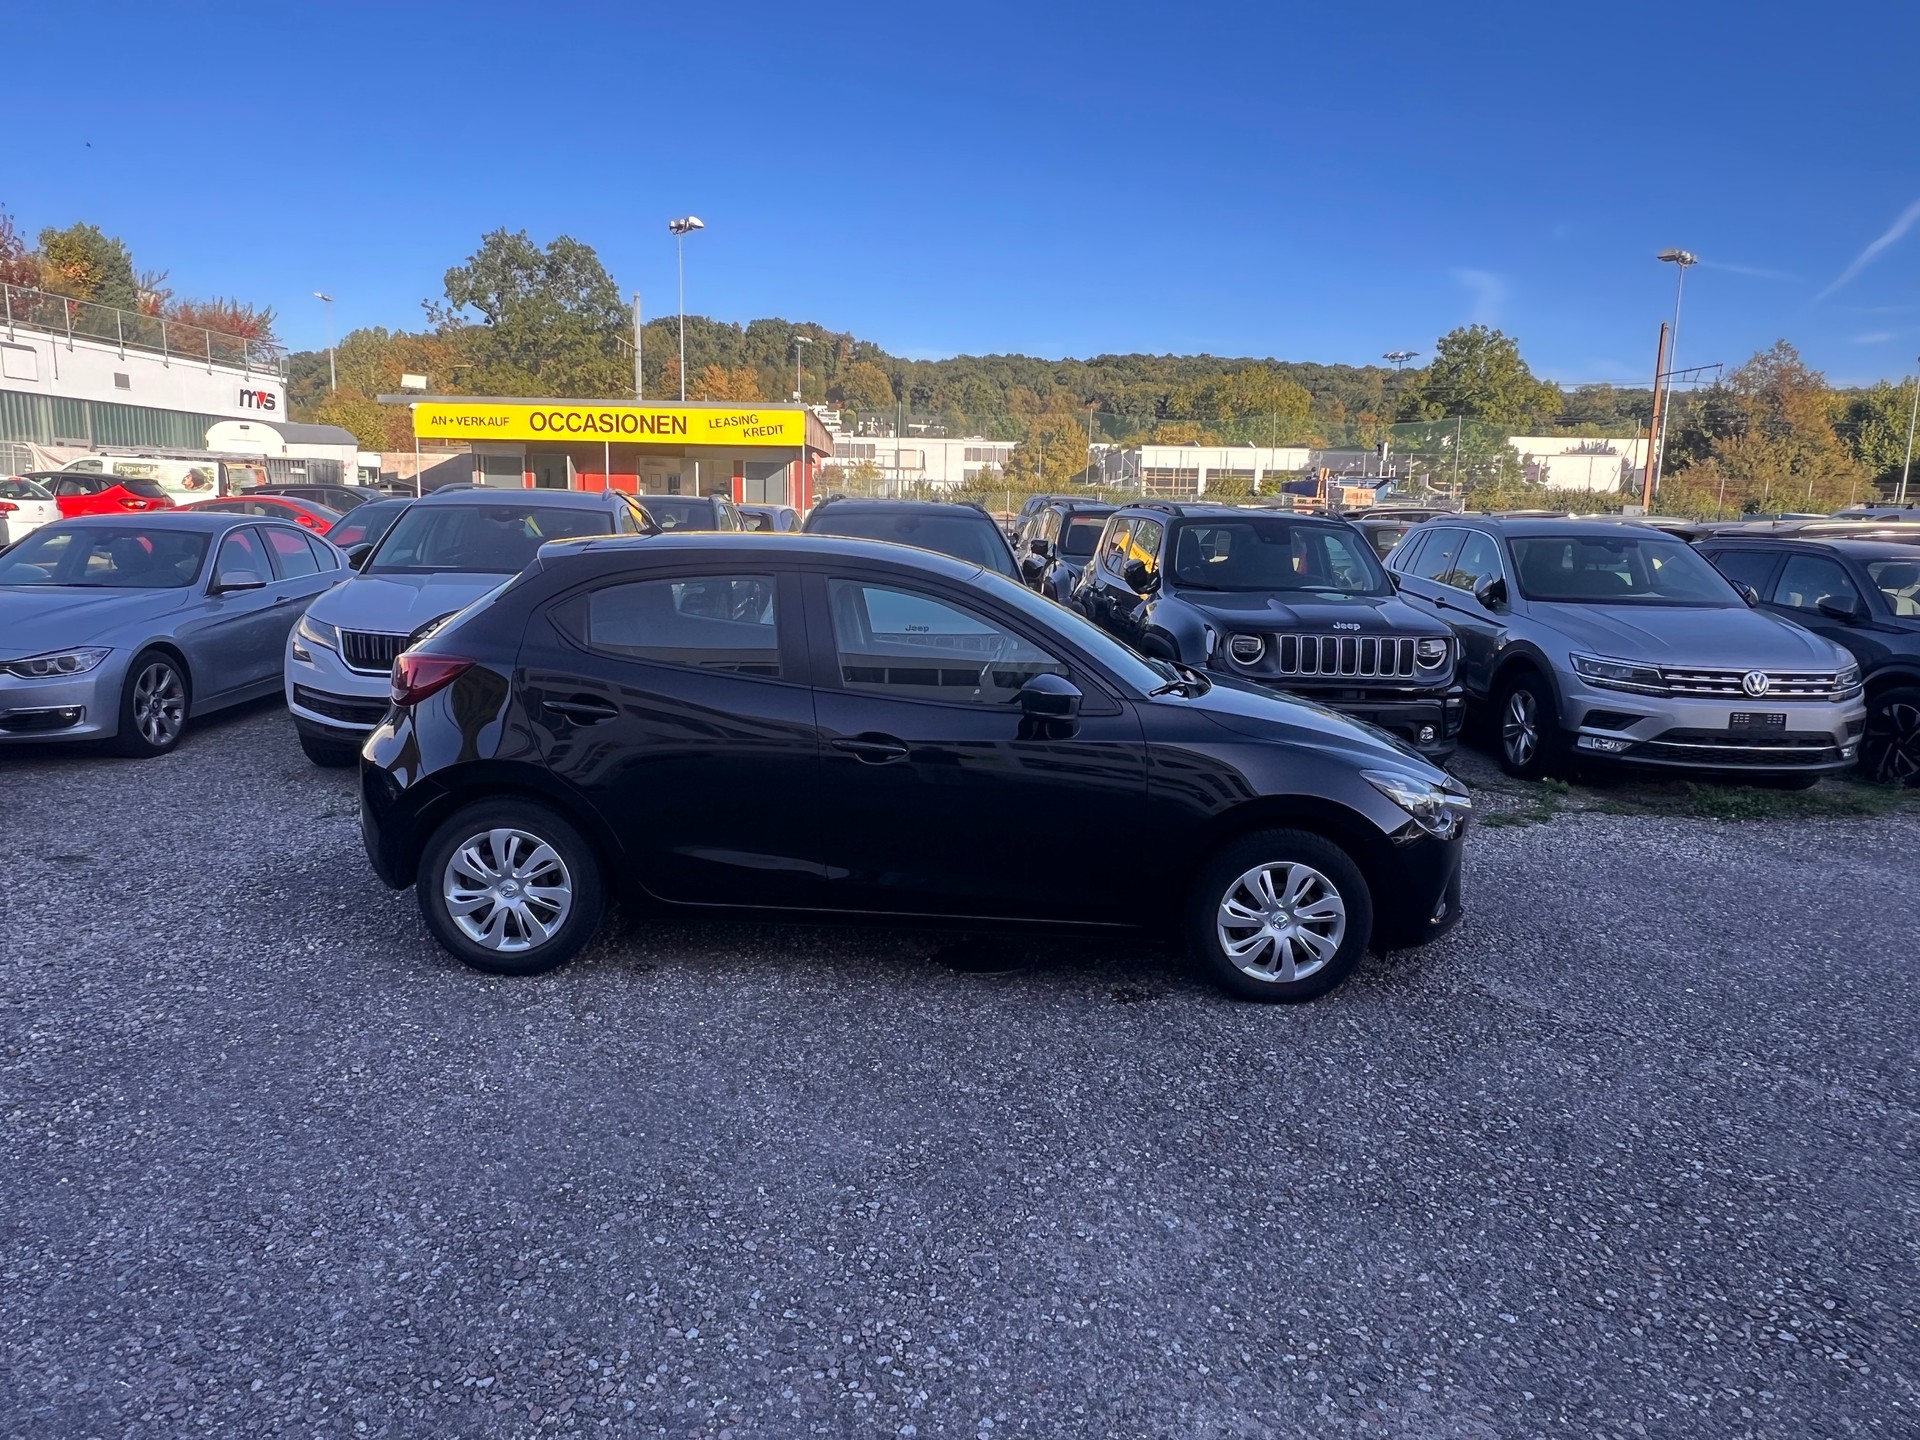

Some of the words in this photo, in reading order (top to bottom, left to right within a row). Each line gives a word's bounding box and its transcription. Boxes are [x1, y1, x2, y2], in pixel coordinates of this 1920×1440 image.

[431, 415, 447, 426] AN
[455, 416, 510, 427] VERKAUF
[529, 411, 687, 435] OCCASIONEN
[708, 413, 759, 429] LEASING
[743, 424, 784, 438] KREDIT
[115, 463, 151, 475] Inspired
[904, 624, 930, 633] Jeep
[1332, 621, 1361, 631] Jeep
